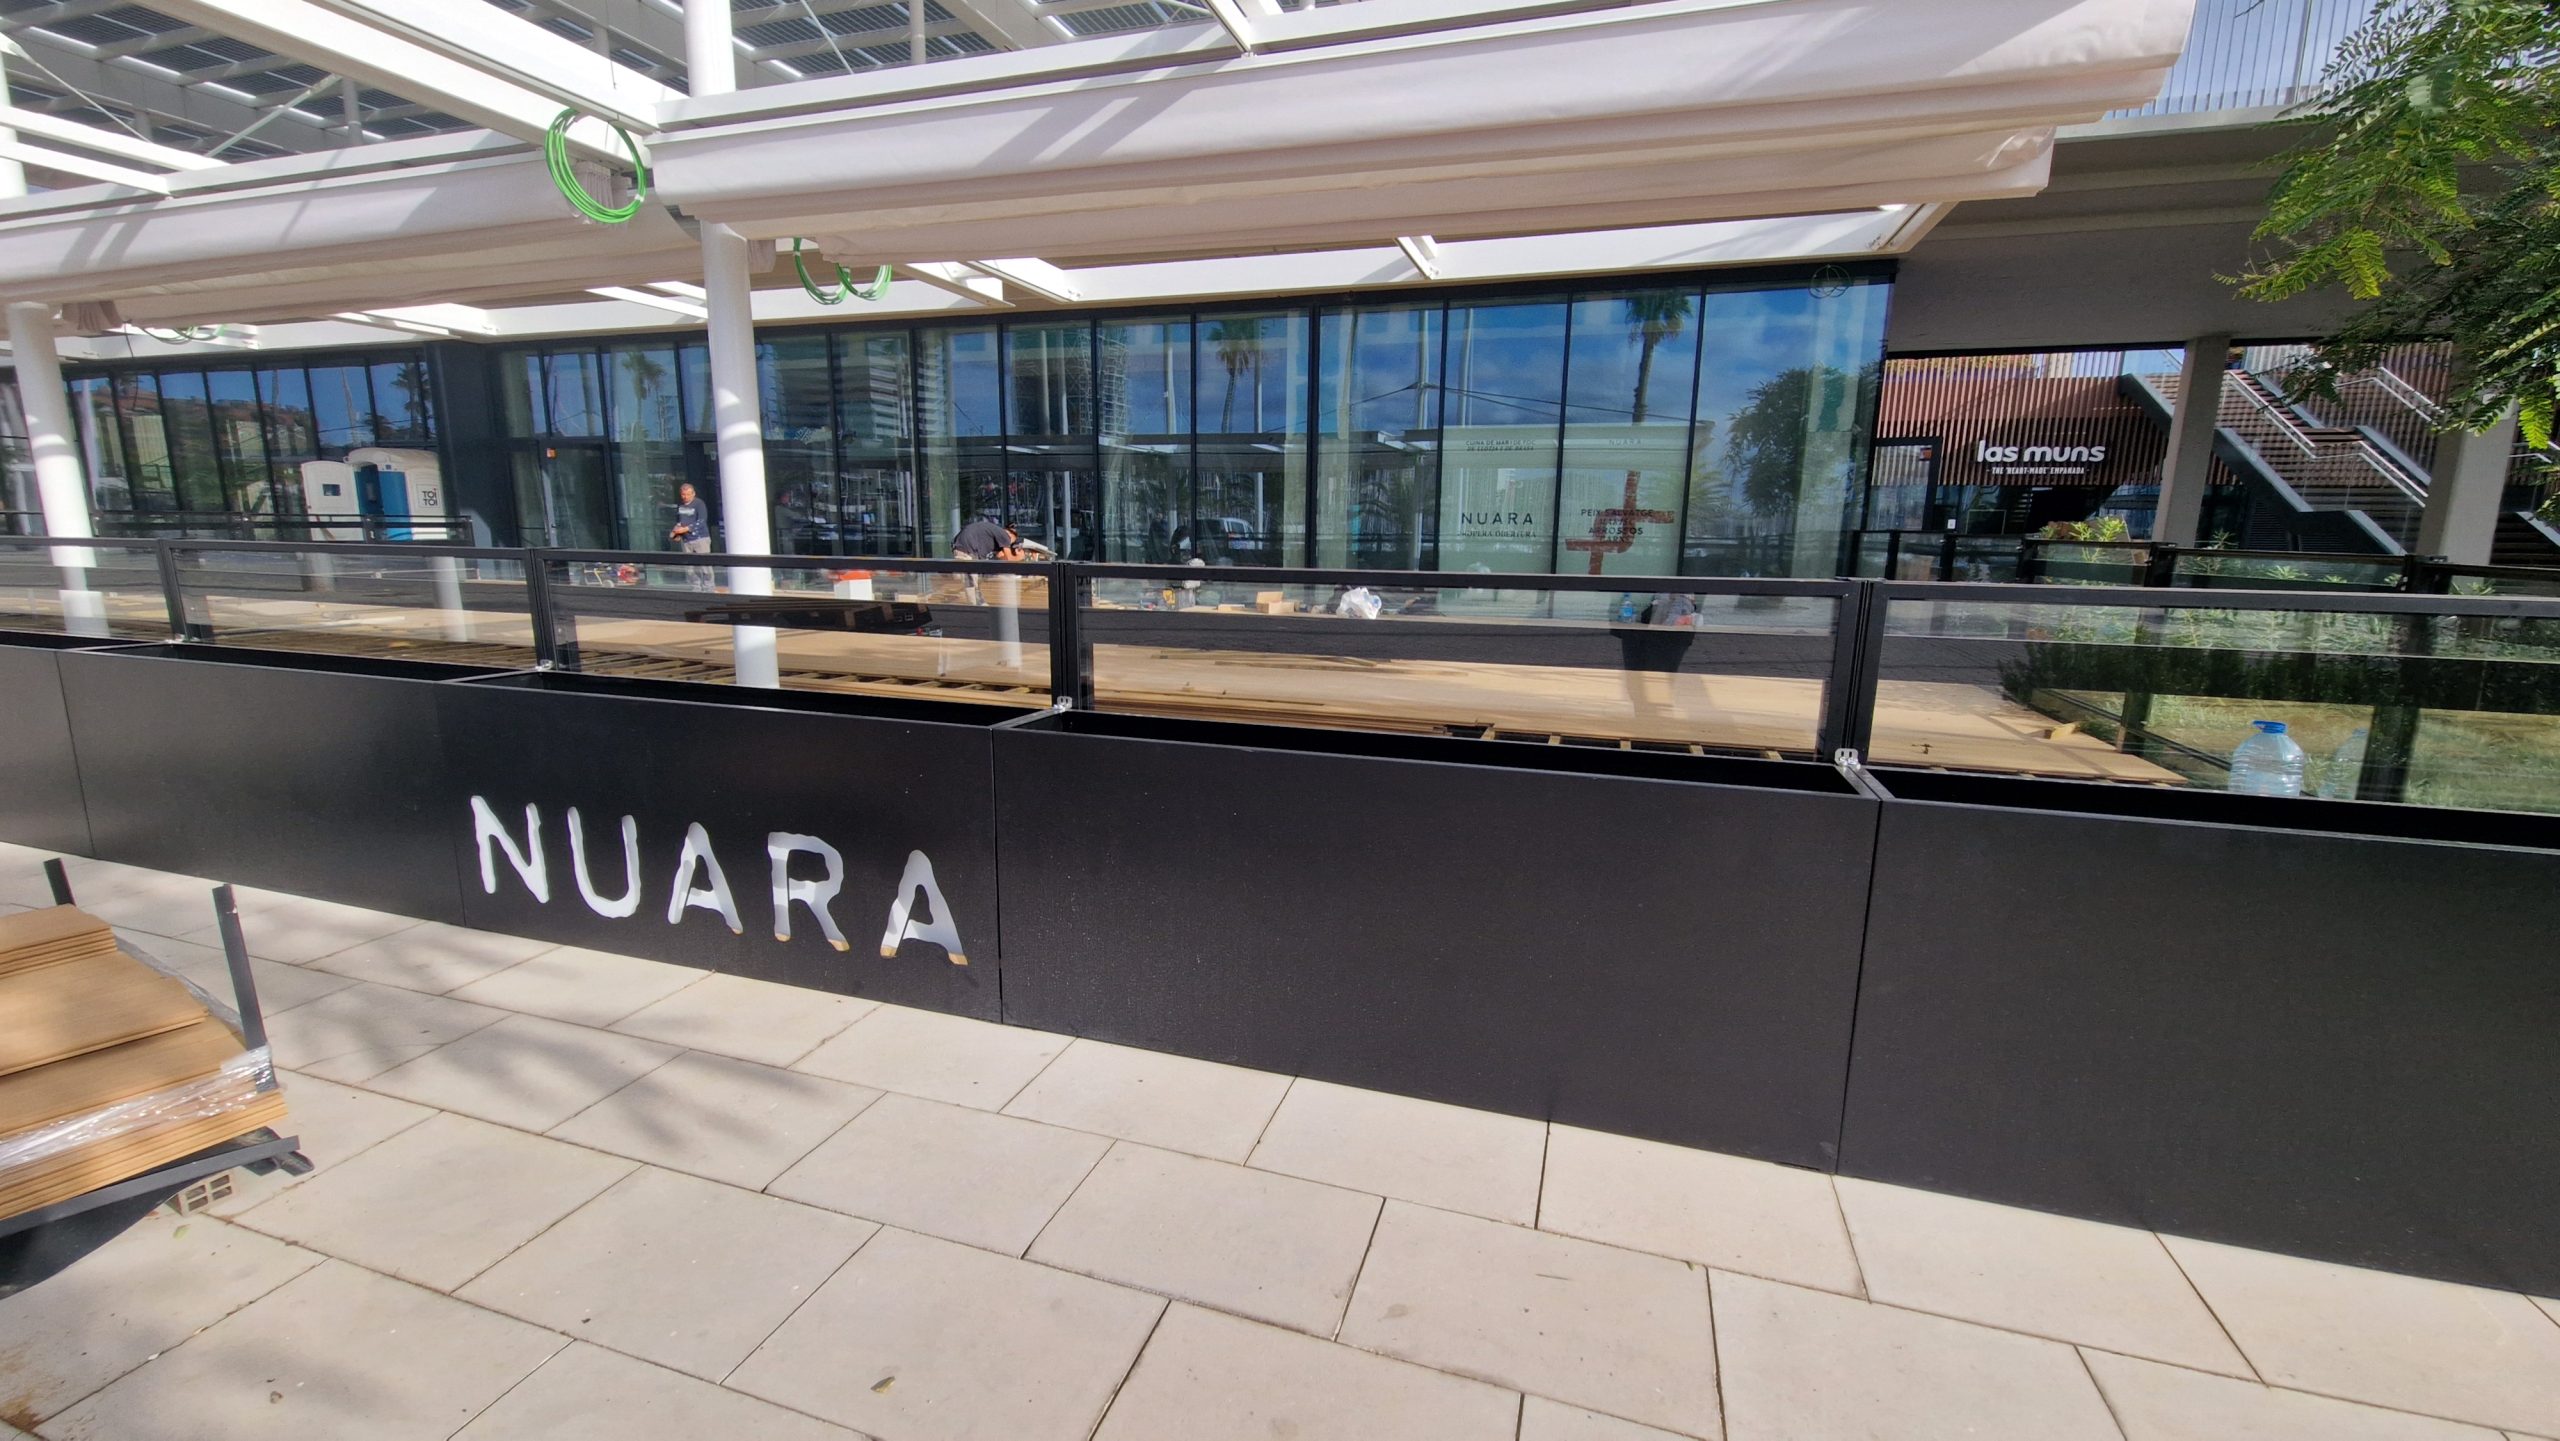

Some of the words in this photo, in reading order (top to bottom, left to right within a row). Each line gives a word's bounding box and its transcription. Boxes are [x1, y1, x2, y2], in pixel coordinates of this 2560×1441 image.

[1977, 439, 2019, 462] las
[2023, 445, 2106, 462] muns
[1992, 466, 2004, 475] THE
[2050, 466, 2085, 475] EMPANADA
[1461, 512, 1533, 525] NUARA
[1580, 508, 1601, 517] PEIX
[1604, 508, 1654, 517] SALVATGE
[470, 794, 969, 967] NUARA
